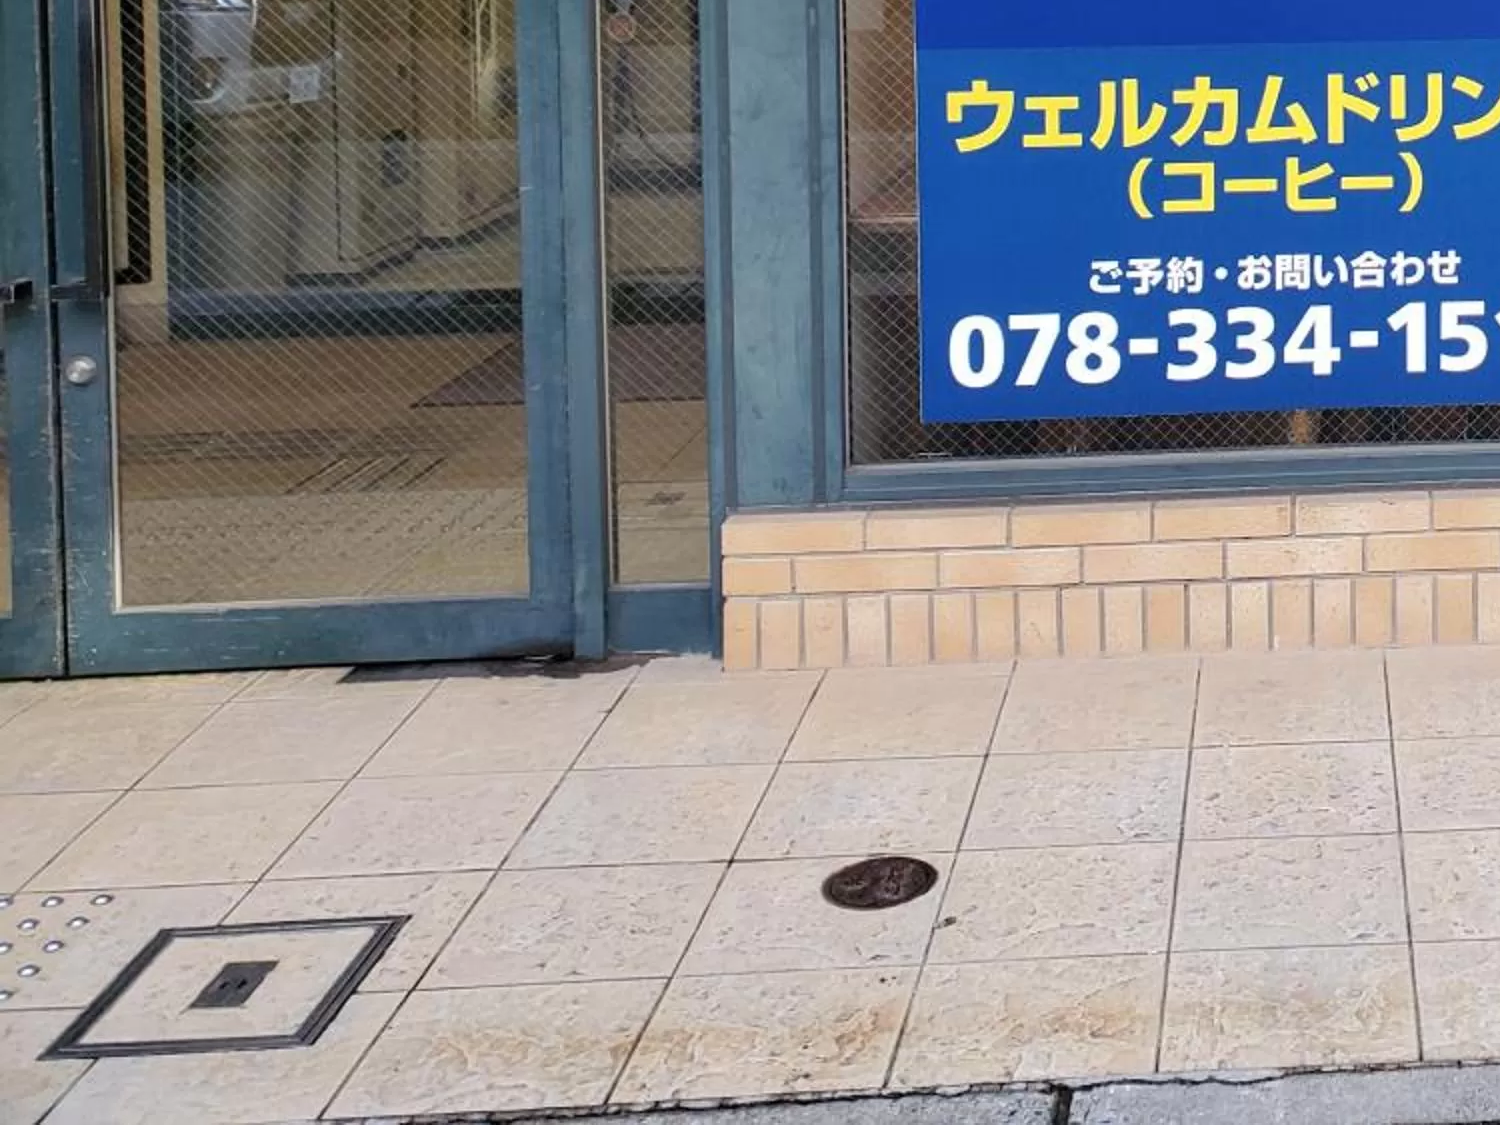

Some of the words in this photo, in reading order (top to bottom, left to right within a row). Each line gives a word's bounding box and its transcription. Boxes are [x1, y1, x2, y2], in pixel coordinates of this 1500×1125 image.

[1089, 250, 1462, 296] ご予約・お問い合わせ
